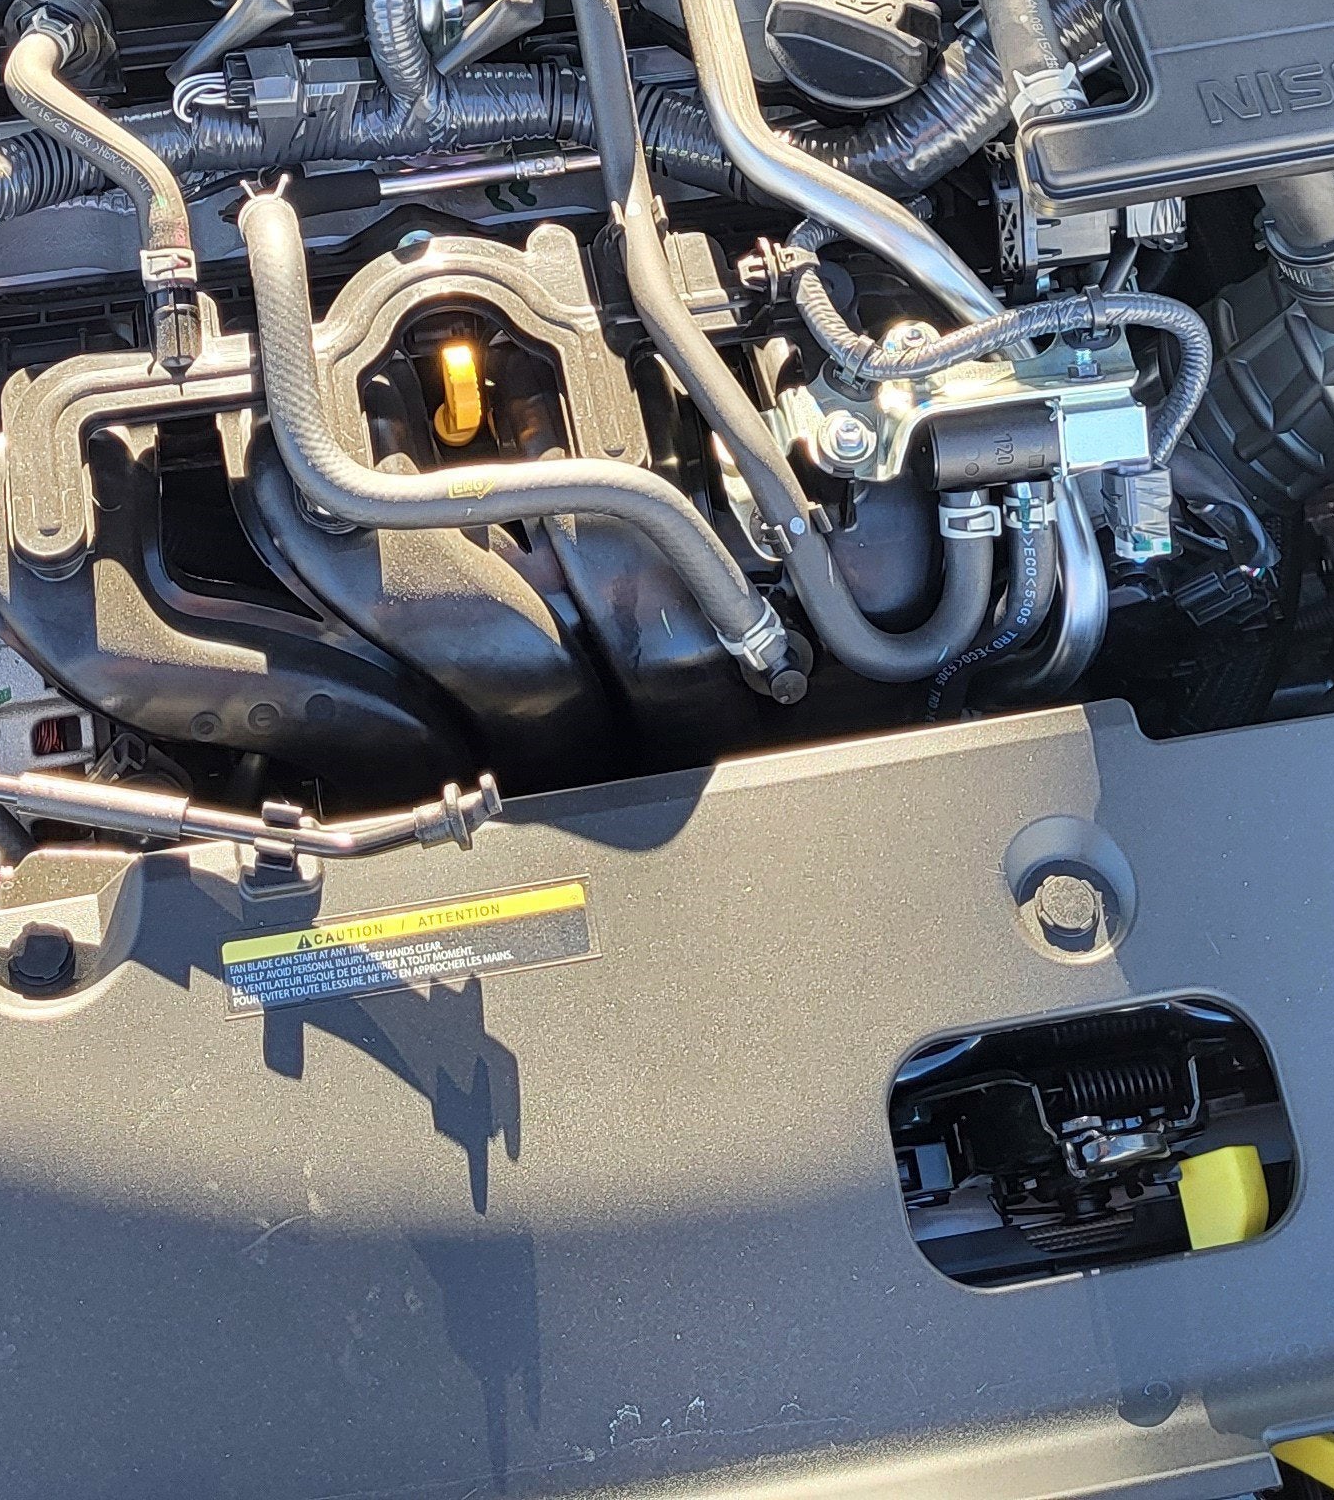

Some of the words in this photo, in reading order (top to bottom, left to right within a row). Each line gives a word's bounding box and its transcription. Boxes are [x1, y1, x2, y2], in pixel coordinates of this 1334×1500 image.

[70, 128, 92, 148] MEX
[995, 432, 1014, 466] 120
[314, 924, 383, 945] CAUTION
[418, 904, 500, 928] ATTENTION
[230, 965, 246, 975] FAN
[247, 959, 273, 971] BLADE
[275, 956, 292, 967] CAN
[293, 952, 317, 964] START
[317, 950, 329, 959] AT
[330, 947, 347, 958] ANY
[348, 943, 369, 955] TIME.
[231, 976, 243, 985] TO
[245, 971, 265, 983] HELP
[266, 968, 291, 980] AVOID
[293, 961, 334, 975] PERSONAL
[335, 955, 365, 968] INJURY,
[366, 951, 385, 962] KEEP
[385, 947, 415, 958] HANDS
[415, 941, 444, 953] CLEAR.
[232, 987, 243, 996] LE
[244, 977, 302, 993] VENTILATEUR
[303, 970, 337, 985] RISQUE
[338, 968, 349, 978] DE
[408, 955, 431, 966] TOUT
[432, 945, 475, 962] MOMENT.
[233, 995, 259, 1007] POUR
[291, 984, 320, 997] TOUTE
[322, 976, 366, 991] BLESSURE,
[367, 973, 380, 983] NE
[381, 970, 397, 981] PAS
[399, 968, 412, 978] EN
[412, 960, 466, 977] APPROCHER
[466, 957, 482, 967] LES
[482, 950, 515, 965] MAINS.
